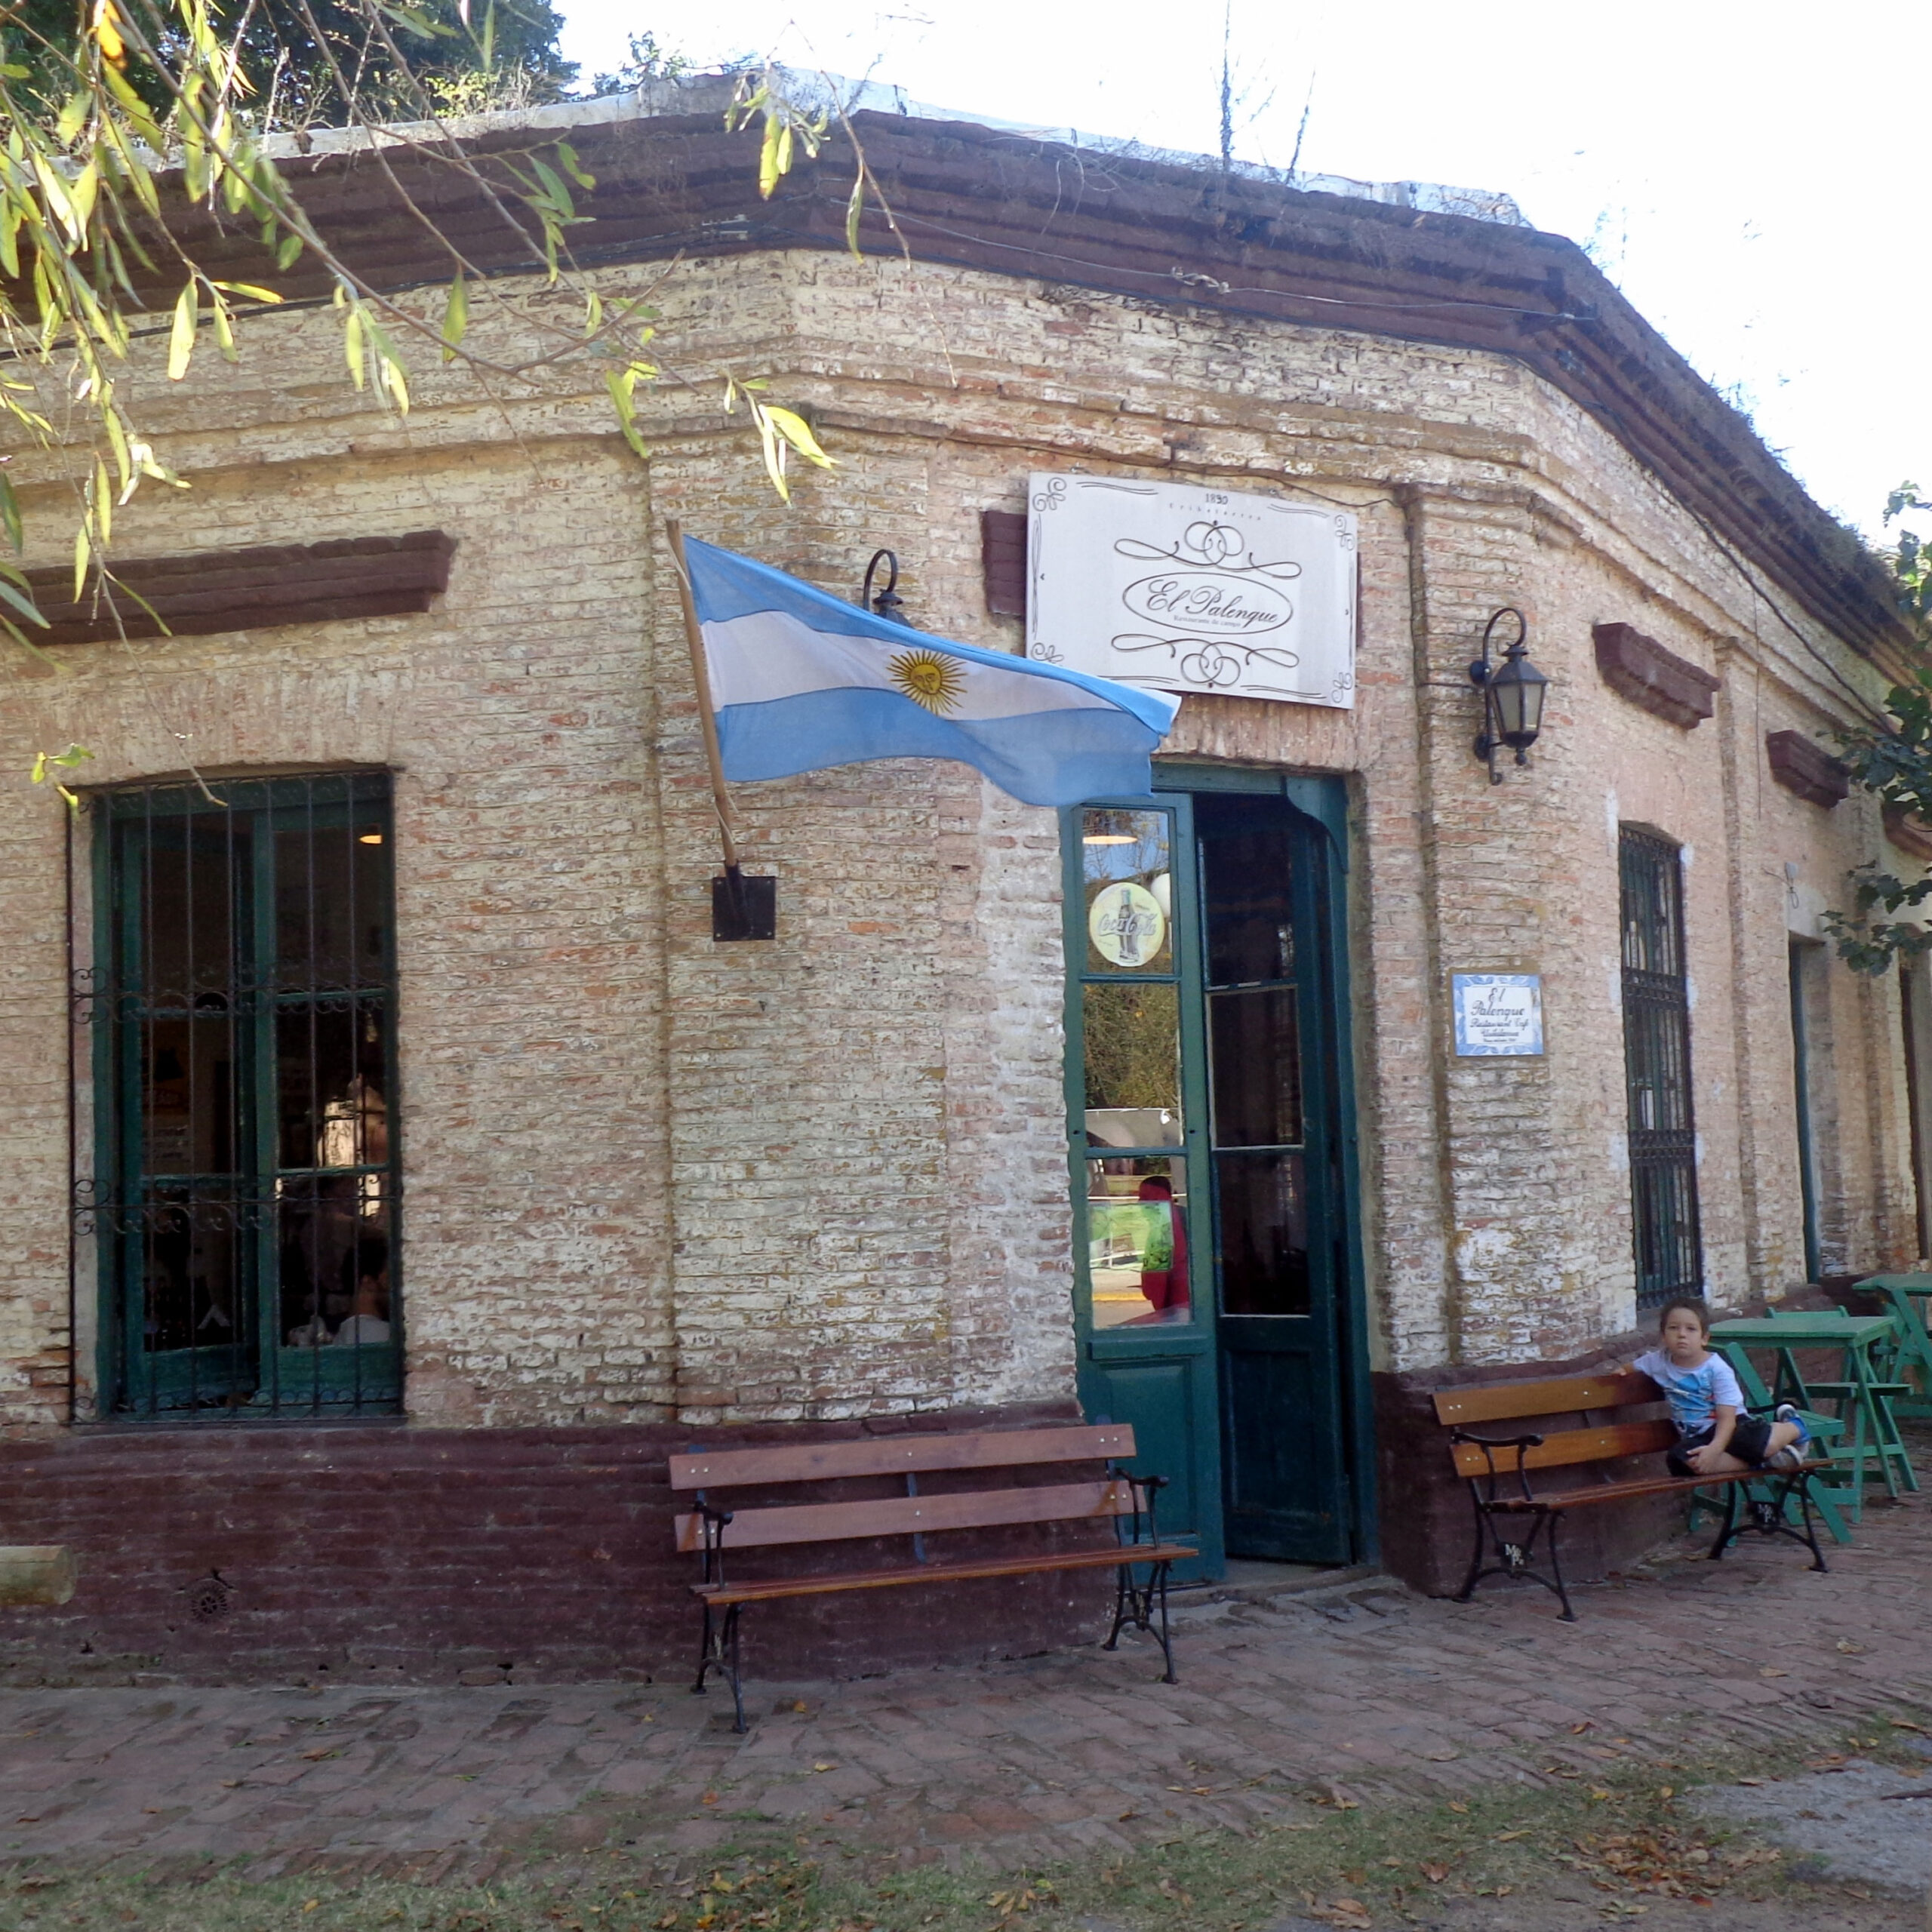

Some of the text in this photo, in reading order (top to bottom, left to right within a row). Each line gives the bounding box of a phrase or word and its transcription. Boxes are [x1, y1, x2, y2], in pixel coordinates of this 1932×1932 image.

[1146, 579, 1278, 629] El Palenque
[1488, 987, 1506, 1002] El
[1470, 1000, 1525, 1021] Palenque
